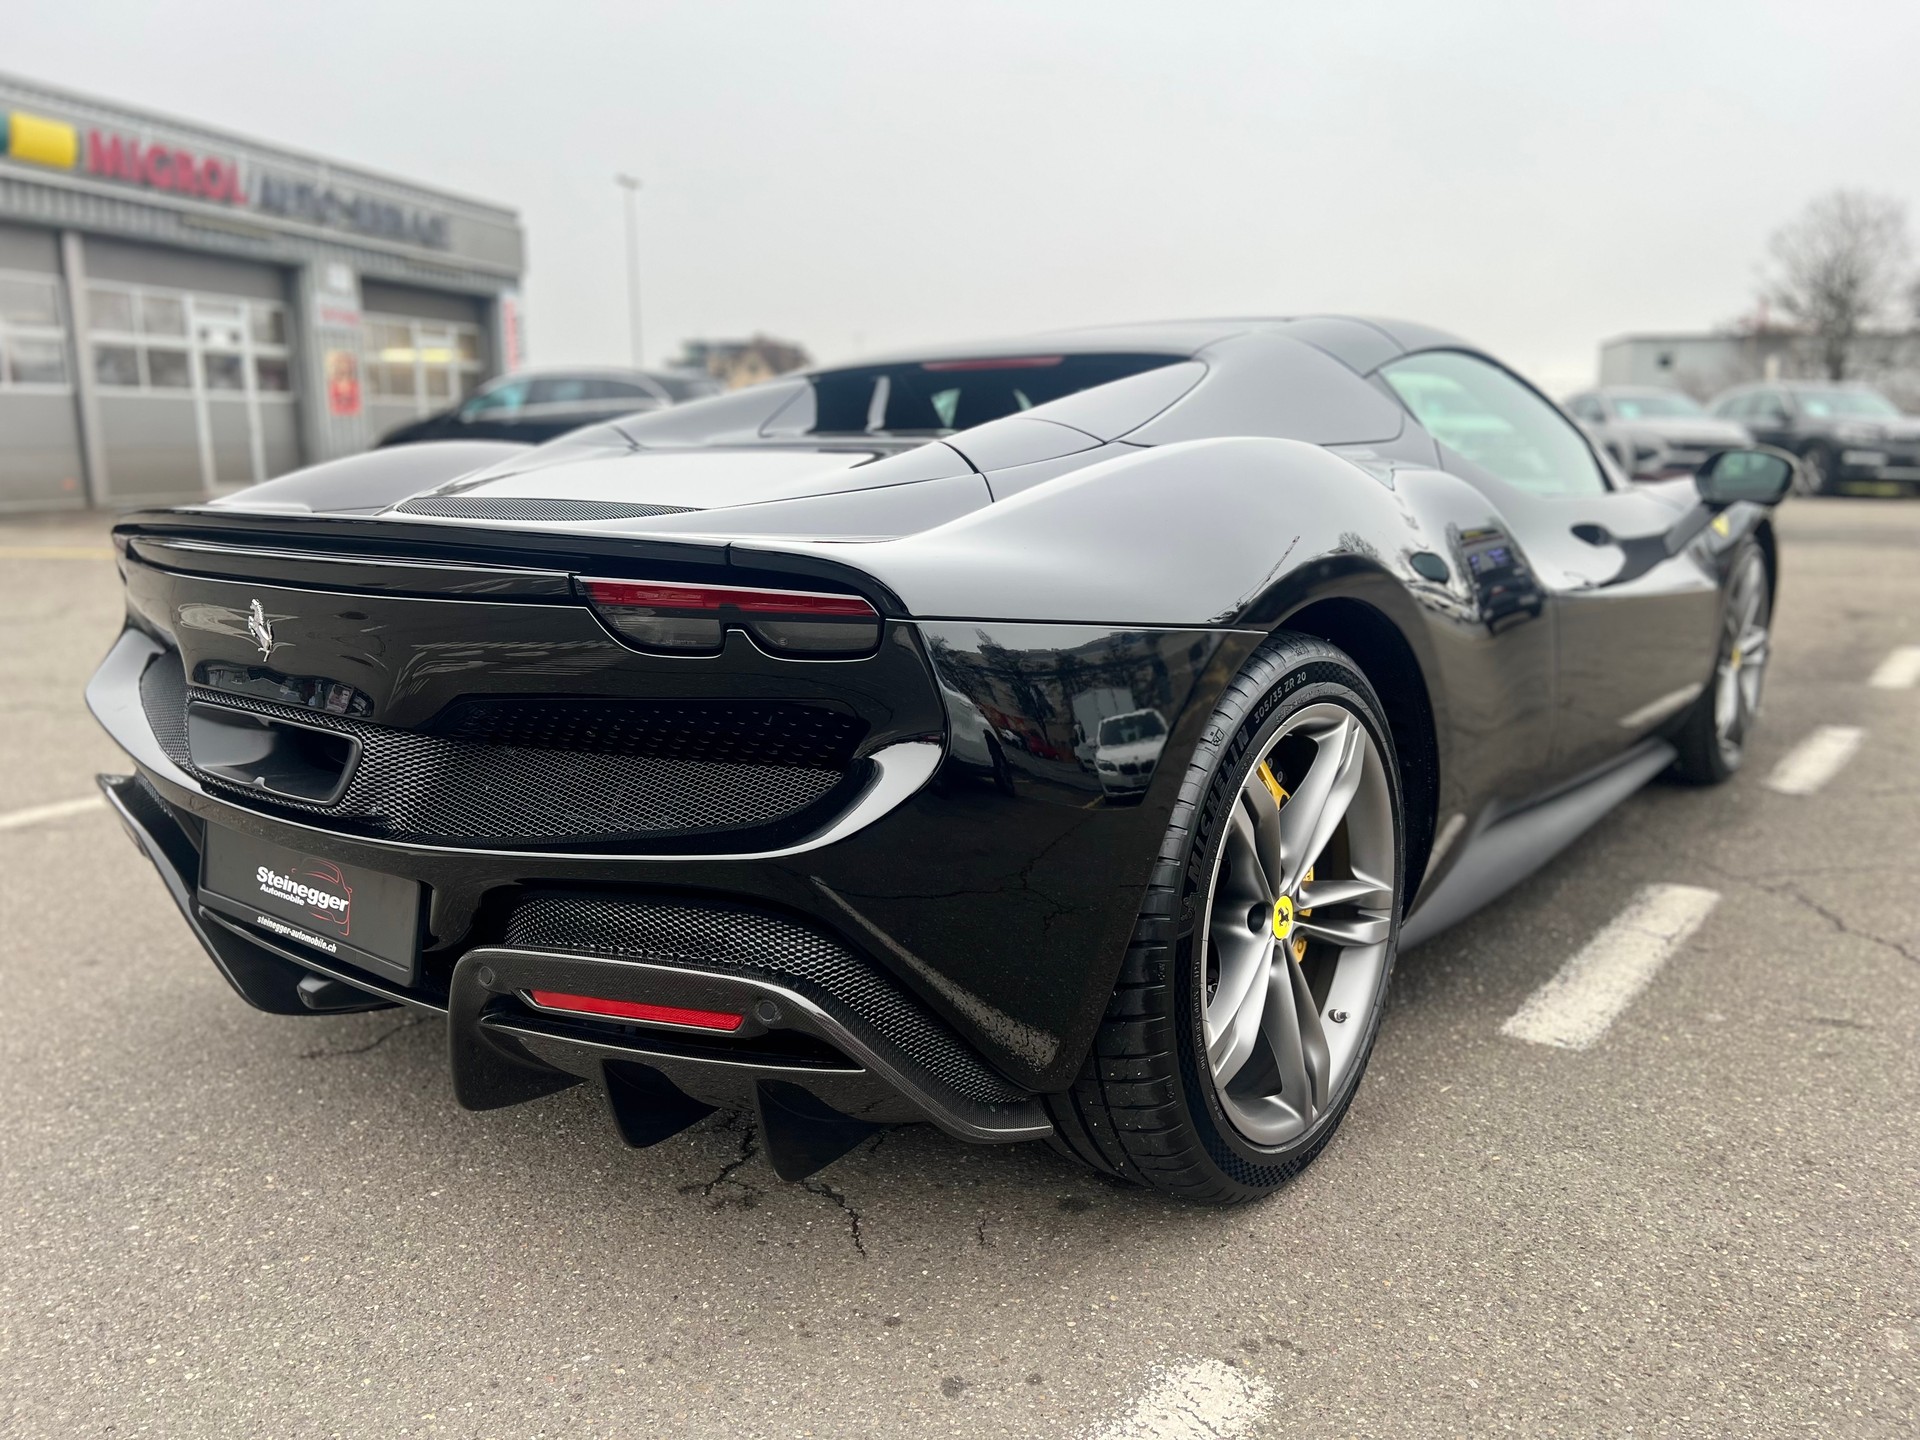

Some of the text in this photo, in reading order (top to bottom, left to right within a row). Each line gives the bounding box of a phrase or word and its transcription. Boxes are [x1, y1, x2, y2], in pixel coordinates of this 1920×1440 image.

[1254, 671, 1307, 724] 305/35 ZR 20
[1187, 724, 1251, 886] MICHELIN
[256, 866, 350, 912] Steinegger
[260, 883, 305, 906] Automobile
[256, 916, 337, 953] steinegger-automobile.ch
